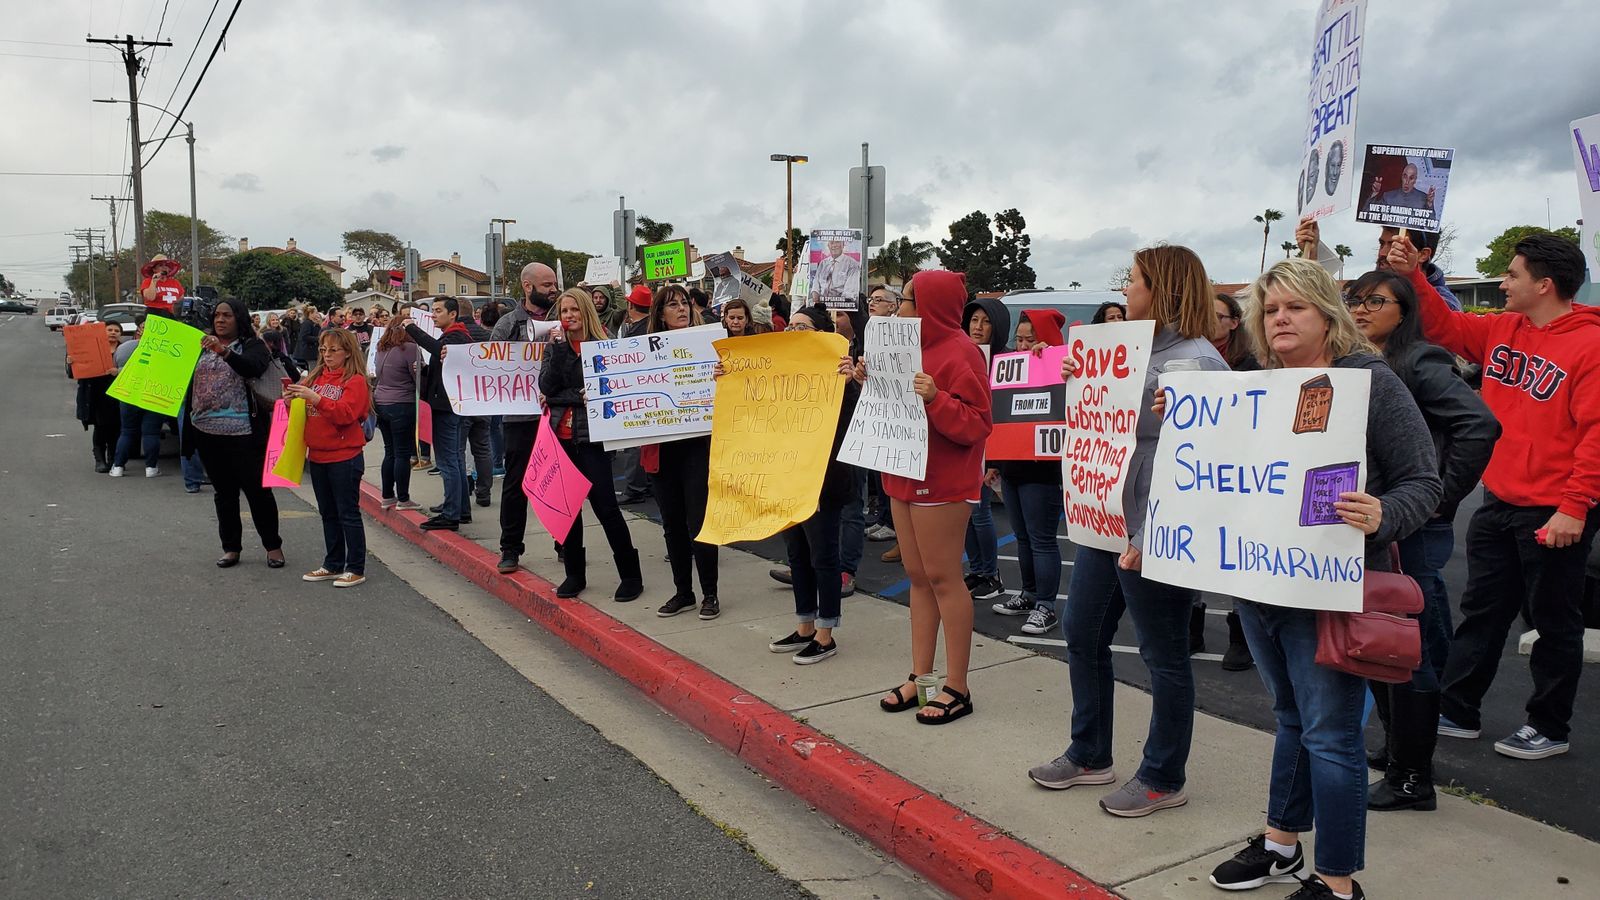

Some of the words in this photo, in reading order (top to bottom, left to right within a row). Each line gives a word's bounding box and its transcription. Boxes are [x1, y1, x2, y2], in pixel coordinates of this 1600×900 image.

[1319, 47, 1361, 104] GOTTA
[1309, 87, 1357, 147] GREAT
[1371, 146, 1427, 157] SUPERINTENDENT
[1358, 211, 1367, 219] AT
[1368, 212, 1381, 220] THE
[1381, 213, 1408, 224] DISTRICT
[1408, 217, 1427, 226] OFFICE
[1426, 219, 1439, 227] TOO
[1369, 203, 1389, 213] WE'RE
[1390, 206, 1412, 215] MAKING
[645, 251, 655, 259] OUR
[656, 248, 680, 258] LIBRARIANS
[654, 257, 674, 266] MUST
[654, 264, 676, 278] STAY
[596, 341, 618, 350] THE
[628, 338, 640, 349] 3
[877, 321, 920, 347] TEACHERS
[478, 341, 515, 362] SAVE
[592, 351, 646, 374] RESCIND
[654, 353, 668, 361] the
[719, 347, 772, 376] Because
[889, 352, 905, 374] ME
[906, 352, 916, 373] 2
[996, 358, 1025, 384] CUT
[1484, 343, 1568, 402] SDSU
[457, 373, 539, 404] LIBRAR
[586, 383, 597, 391] 2.
[598, 376, 632, 396] ROLL
[637, 372, 670, 386] BACK
[744, 373, 768, 402] NO
[773, 373, 840, 407] STUDENT
[864, 374, 889, 400] STAND
[602, 396, 661, 420] REFLECT
[644, 408, 674, 419] NEGATIVE
[891, 403, 901, 420] SO
[1014, 398, 1035, 411] FROM
[1035, 397, 1048, 410] THE
[1162, 385, 1268, 430] DON'T
[1302, 410, 1311, 418] OF
[624, 419, 650, 429] CULTURE
[656, 416, 682, 426] EQUITY
[731, 404, 778, 434] EVER
[782, 406, 824, 434] SAID
[1302, 416, 1324, 425] DEBT
[872, 420, 916, 441] STANDING
[918, 428, 928, 448] UP
[527, 439, 548, 482] SAVE
[782, 449, 800, 473] my
[849, 439, 864, 462] 4
[872, 444, 922, 477] THEM
[1174, 441, 1290, 495] SHELVE
[1313, 488, 1334, 497] TAKE
[1315, 477, 1329, 486] HOW
[1330, 476, 1343, 484] TO
[1147, 498, 1196, 564] YOUR
[1218, 525, 1364, 584] LIBRARIANS
